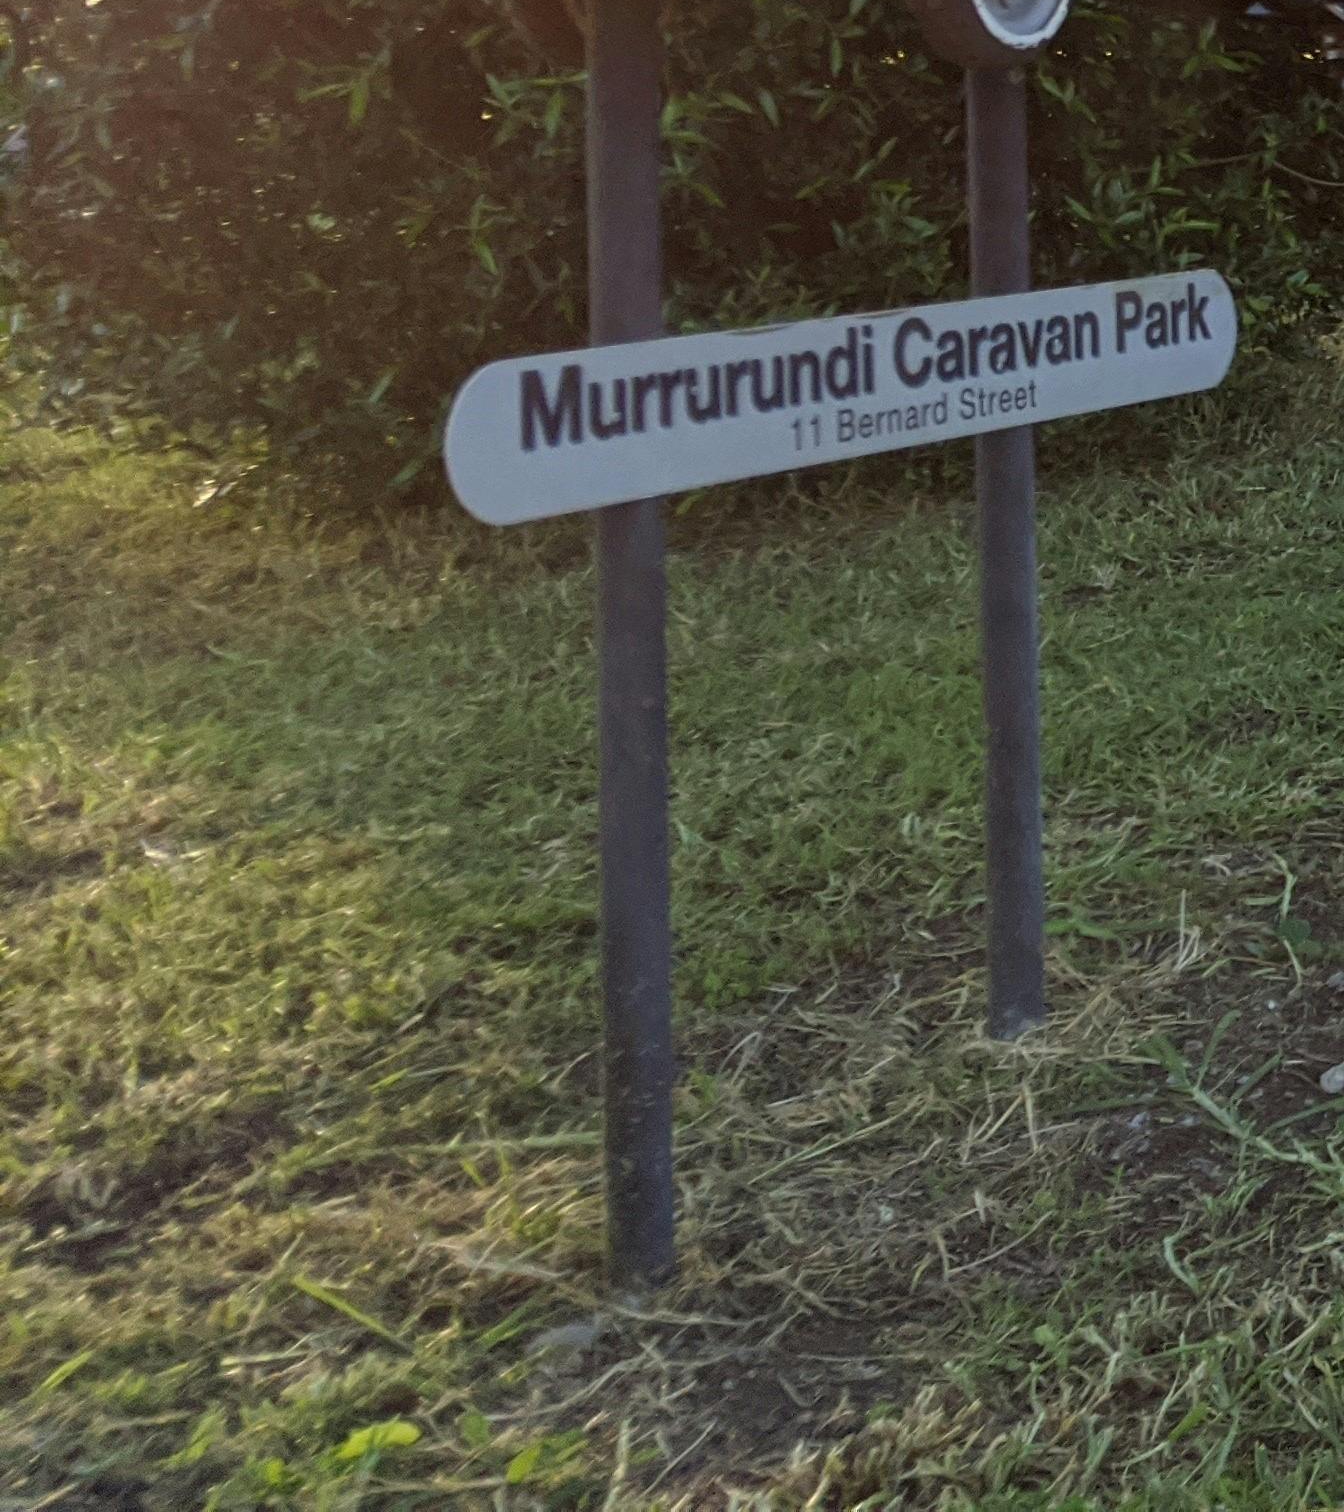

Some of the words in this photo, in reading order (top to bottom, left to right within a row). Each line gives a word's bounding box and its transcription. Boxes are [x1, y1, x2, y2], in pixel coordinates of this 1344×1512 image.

[520, 323, 875, 451] Murrurundi
[893, 309, 1101, 388] Caravan
[1114, 282, 1213, 354] Park
[790, 413, 823, 451] 11
[836, 393, 949, 444] Bernard
[959, 380, 1038, 421] Street
